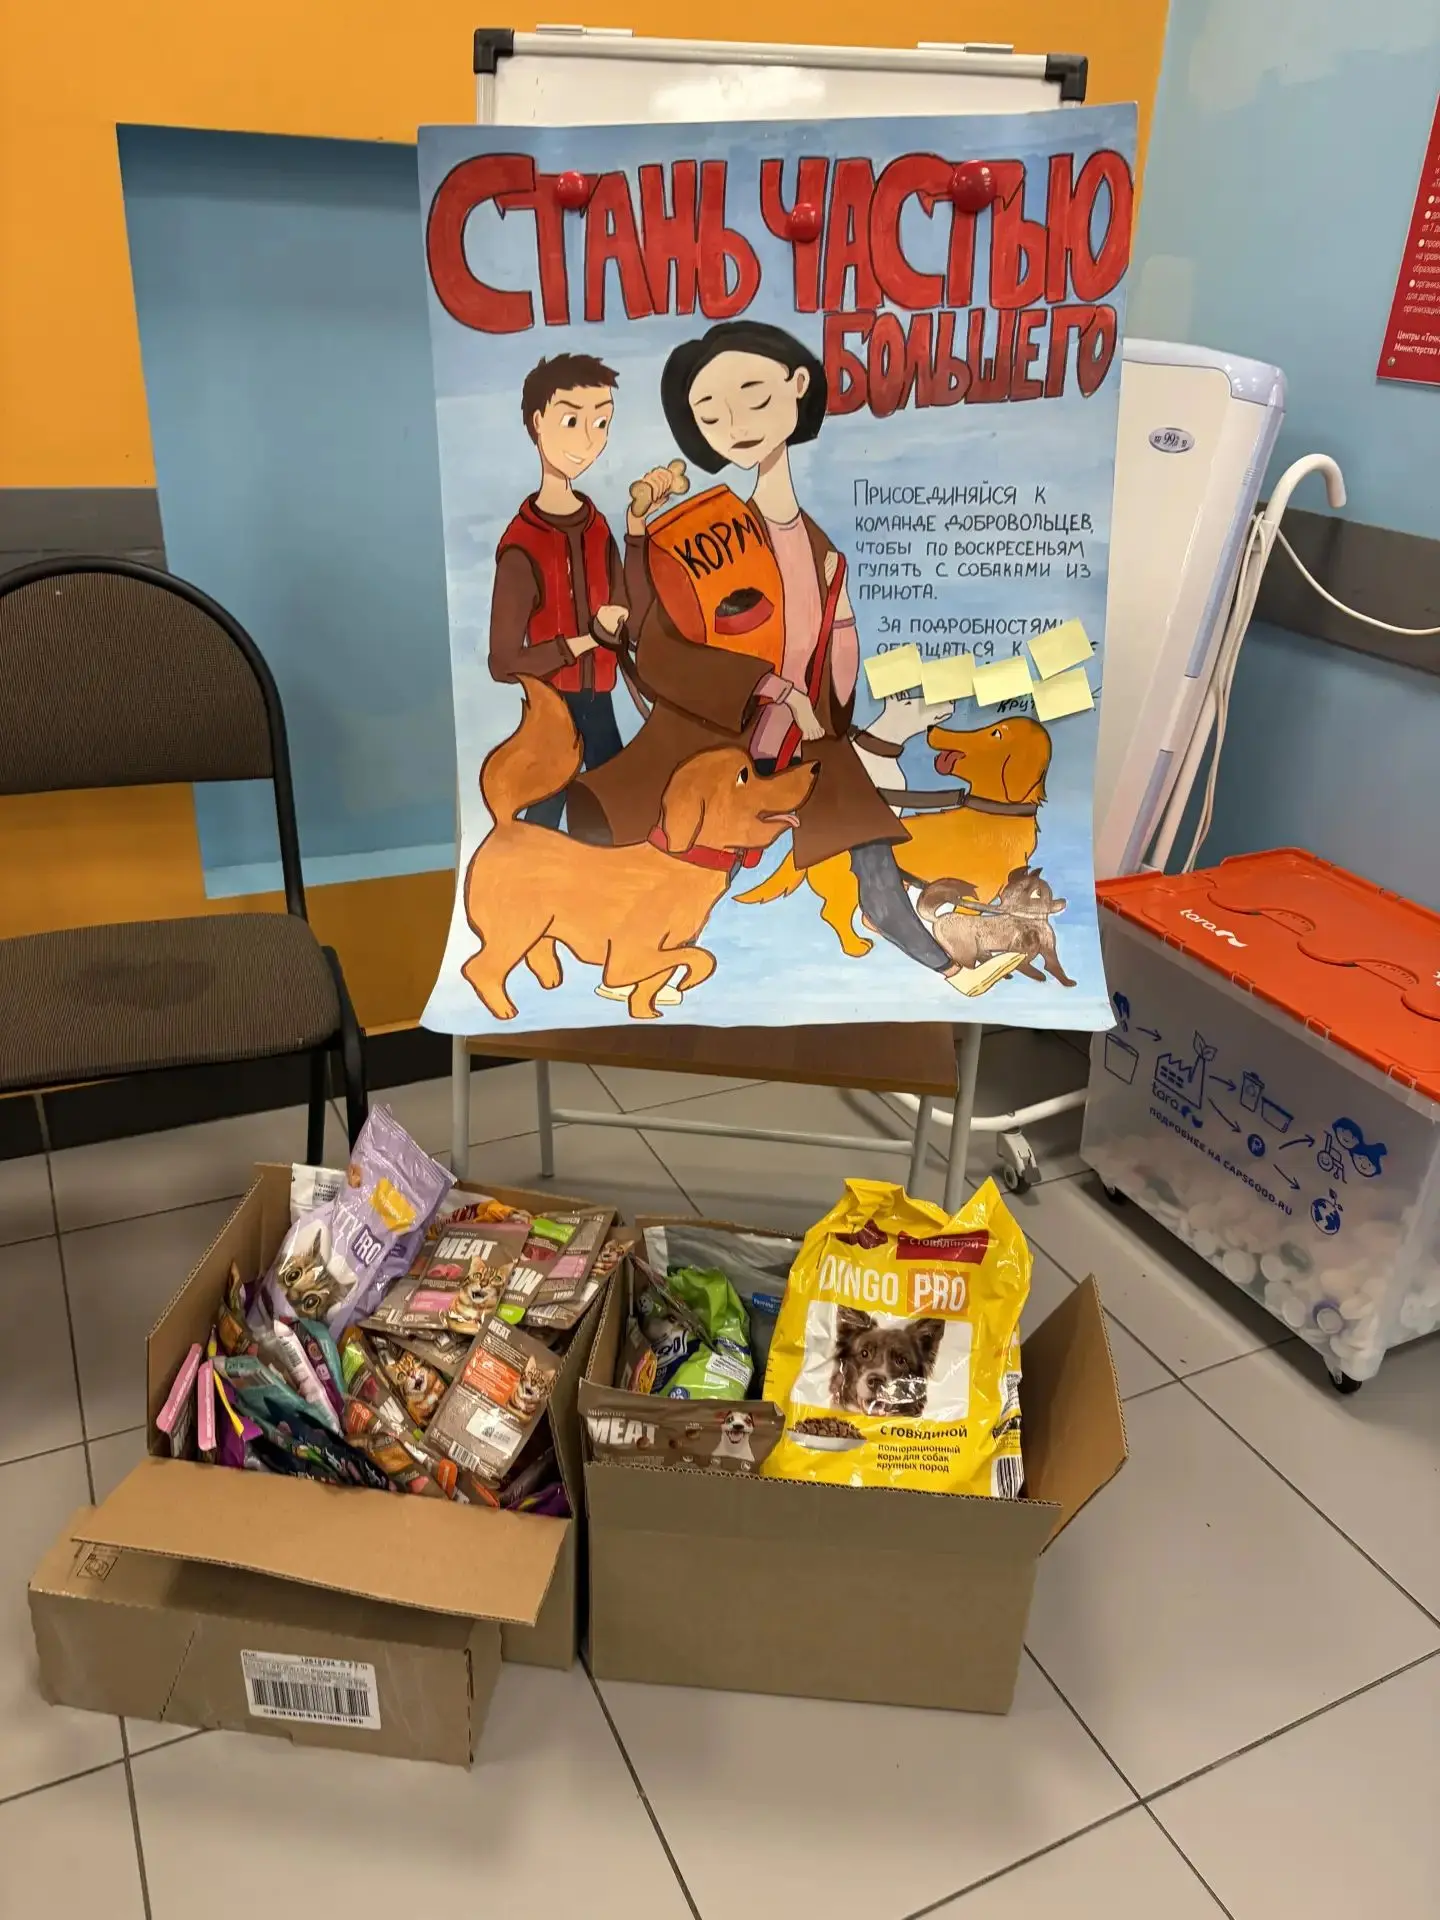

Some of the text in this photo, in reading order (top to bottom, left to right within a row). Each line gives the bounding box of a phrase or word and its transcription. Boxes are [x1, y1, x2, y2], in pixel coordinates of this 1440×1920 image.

[427, 149, 1132, 334] СТАНЬ ЧАСТЬЮ
[1397, 330, 1421, 342] Центры
[1393, 343, 1437, 356] Министерства
[823, 305, 1118, 418] БОЛЬШЕГО
[855, 513, 1095, 536] КОМАНДЕ ДОБРОВОЛЬЦЕВ,
[673, 512, 763, 579] КОРМ
[855, 540, 1085, 559] ЧТОБЫ ПО ВОСКРЕСЕНЬЯМ
[935, 562, 949, 578] С
[957, 562, 1051, 578] СОБАКАМИ
[1066, 563, 1092, 579] ИЗ
[858, 583, 938, 601] ПРИЮТА.
[877, 616, 901, 634] ЗА
[1012, 641, 1023, 656] К
[1149, 1107, 1294, 1217] ПОДРОБНЕЕ НА CAPSGOOD.RU
[434, 1236, 499, 1261] MEAT
[819, 1254, 967, 1312] DINGO PRO
[487, 1319, 512, 1341] MEAT
[587, 1416, 659, 1446] MEAT
[876, 1461, 950, 1474] крупных пород
[877, 1452, 950, 1463] корм для собак
